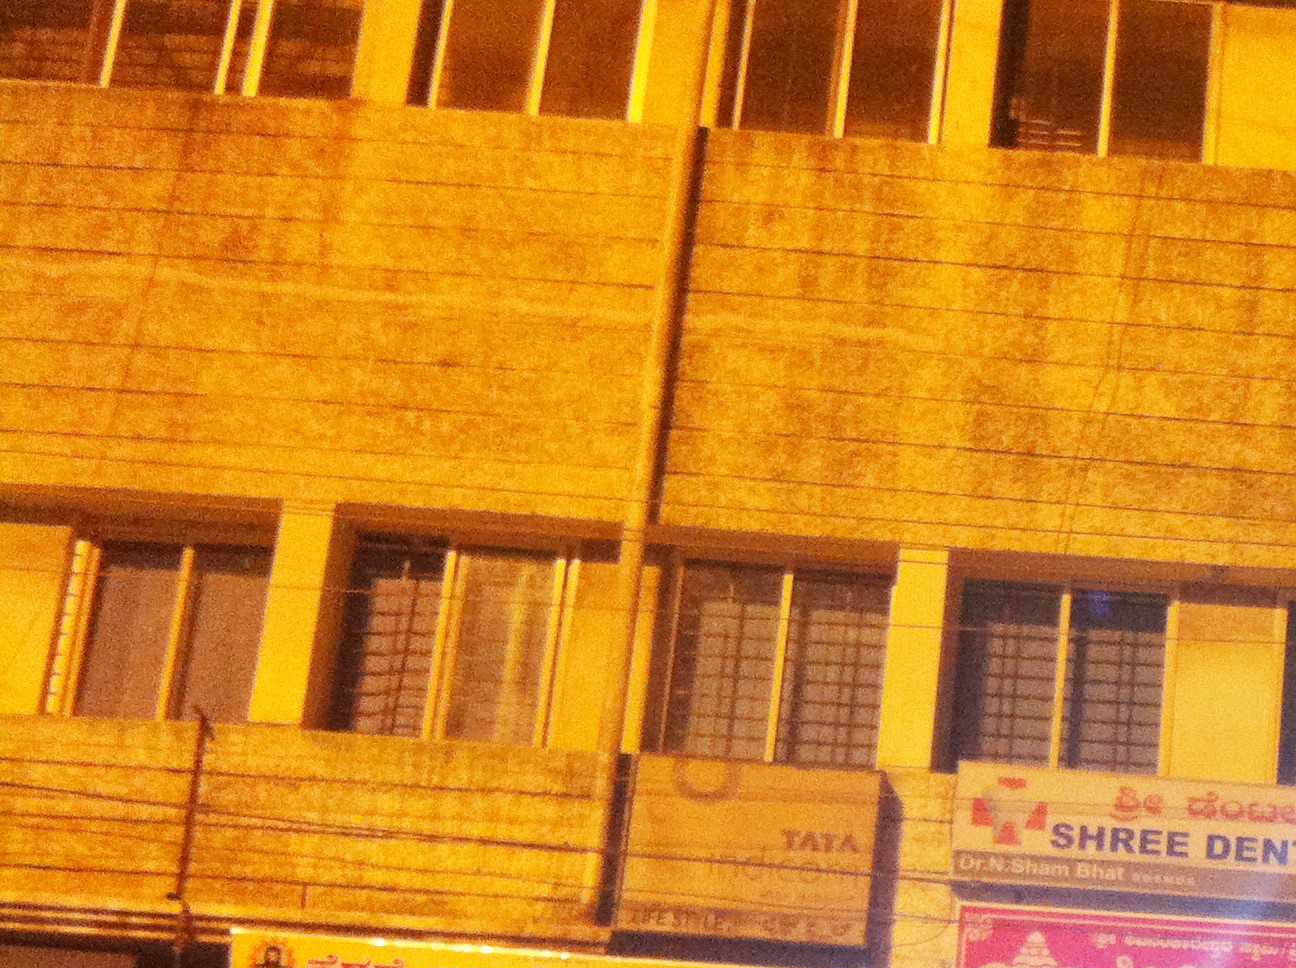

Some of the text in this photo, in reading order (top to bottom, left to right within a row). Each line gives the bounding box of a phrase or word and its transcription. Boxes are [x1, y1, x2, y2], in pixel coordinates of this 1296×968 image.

[783, 829, 861, 855] TATA
[1051, 822, 1190, 858] SHREE
[1076, 862, 1124, 881] Bhat
